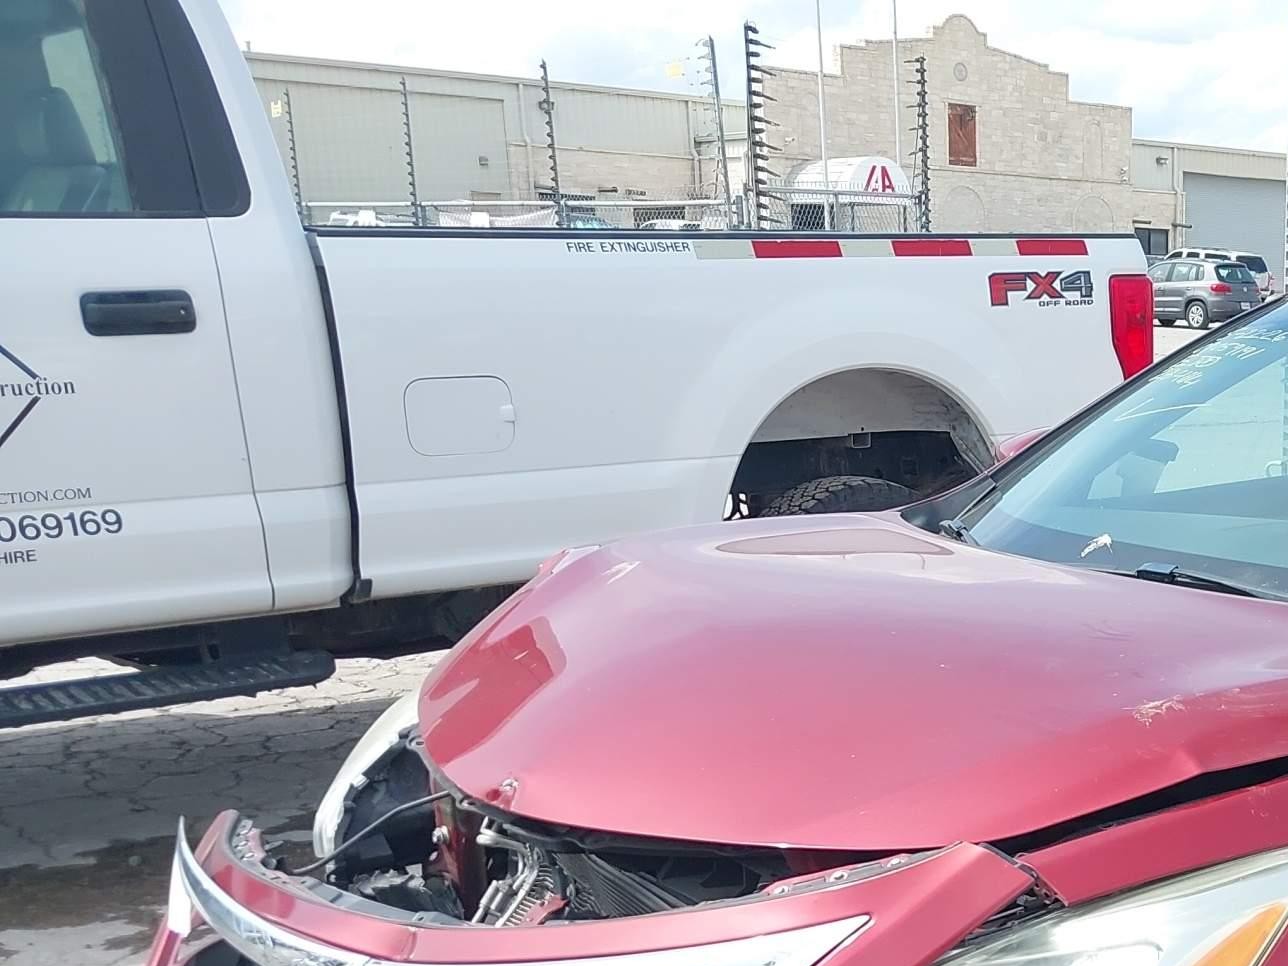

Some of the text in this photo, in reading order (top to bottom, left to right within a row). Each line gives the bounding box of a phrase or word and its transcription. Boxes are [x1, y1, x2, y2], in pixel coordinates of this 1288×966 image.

[566, 241, 691, 253] FIRE EXTINGUISHER
[988, 270, 1094, 307] FX4
[1038, 299, 1061, 307] OFF
[0, 377, 76, 397] ruction
[0, 508, 123, 543] 069169
[0, 549, 37, 565] HIRE
